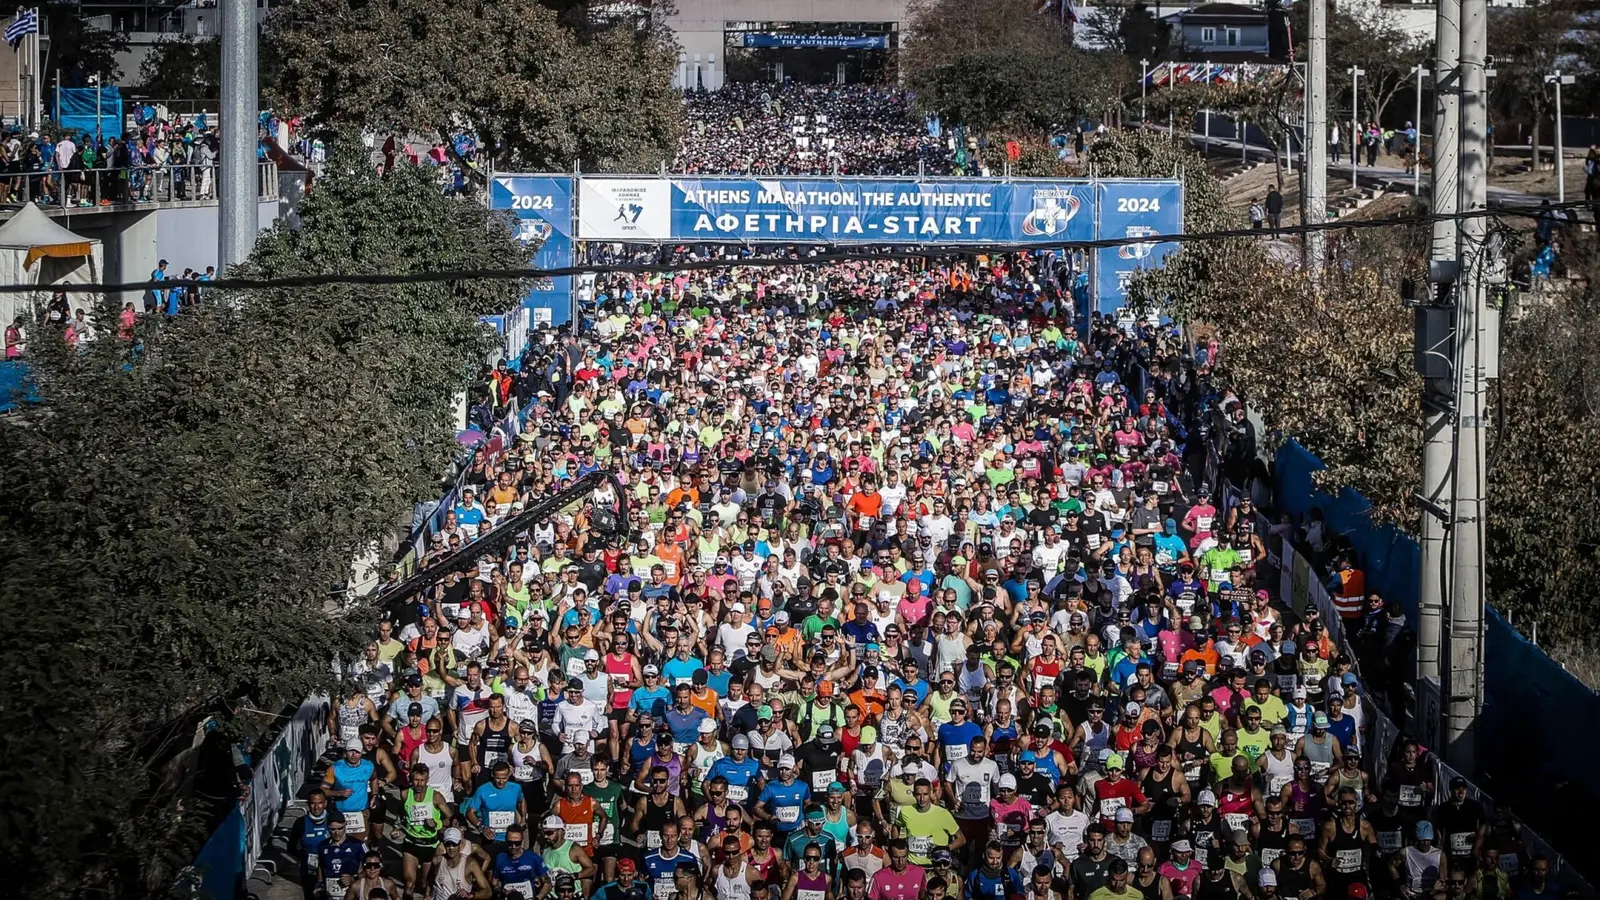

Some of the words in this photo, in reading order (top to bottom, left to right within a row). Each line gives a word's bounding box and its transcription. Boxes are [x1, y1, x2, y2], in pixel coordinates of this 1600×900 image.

[511, 195, 554, 210] 2024
[684, 190, 750, 204] ATHENS
[756, 190, 858, 206] MARATHON.
[862, 192, 894, 206] THE
[897, 192, 992, 207] AUTHENTIC
[1118, 198, 1160, 212] 2024
